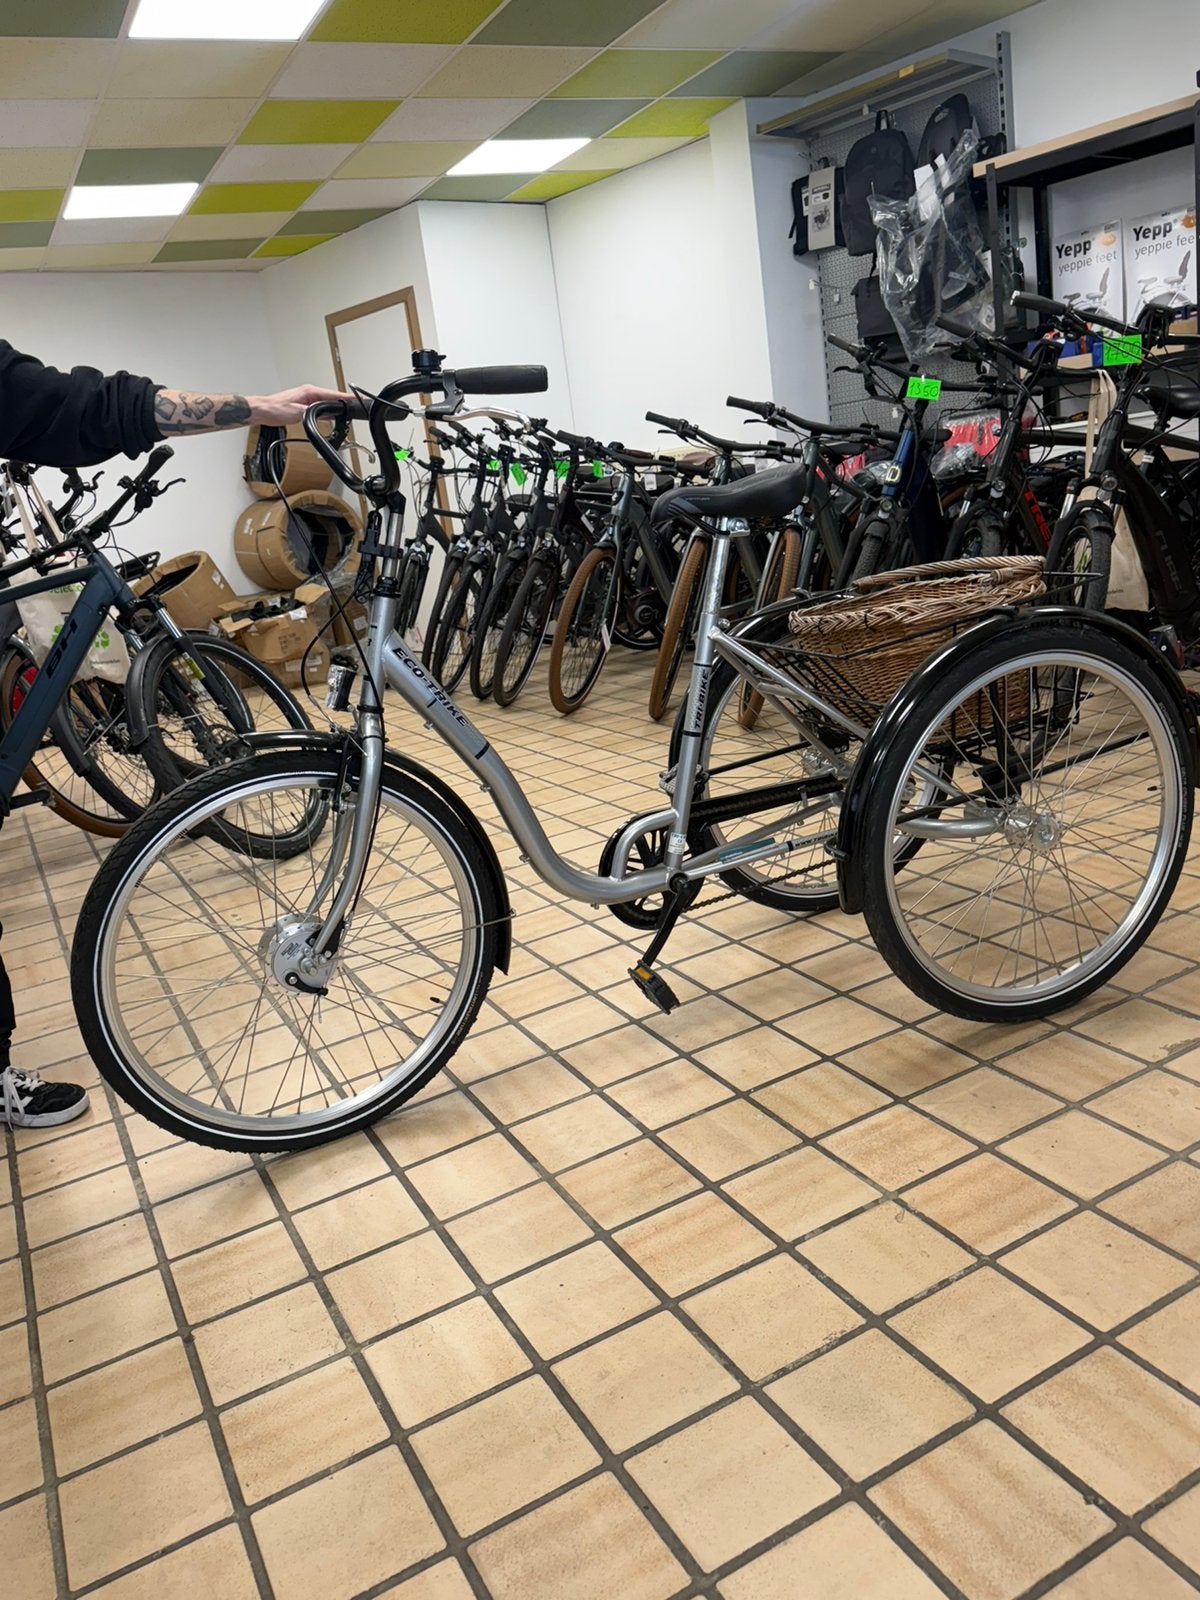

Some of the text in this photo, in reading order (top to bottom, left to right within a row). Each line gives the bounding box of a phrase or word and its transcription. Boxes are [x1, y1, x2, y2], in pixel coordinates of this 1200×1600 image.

[1133, 221, 1172, 241] Yepp
[1056, 240, 1092, 258] Yepp
[1135, 234, 1195, 259] yeppie fee
[1058, 250, 1117, 276] yeppie feet
[910, 382, 939, 397] 1350
[393, 647, 468, 727] ECO-TRIKE
